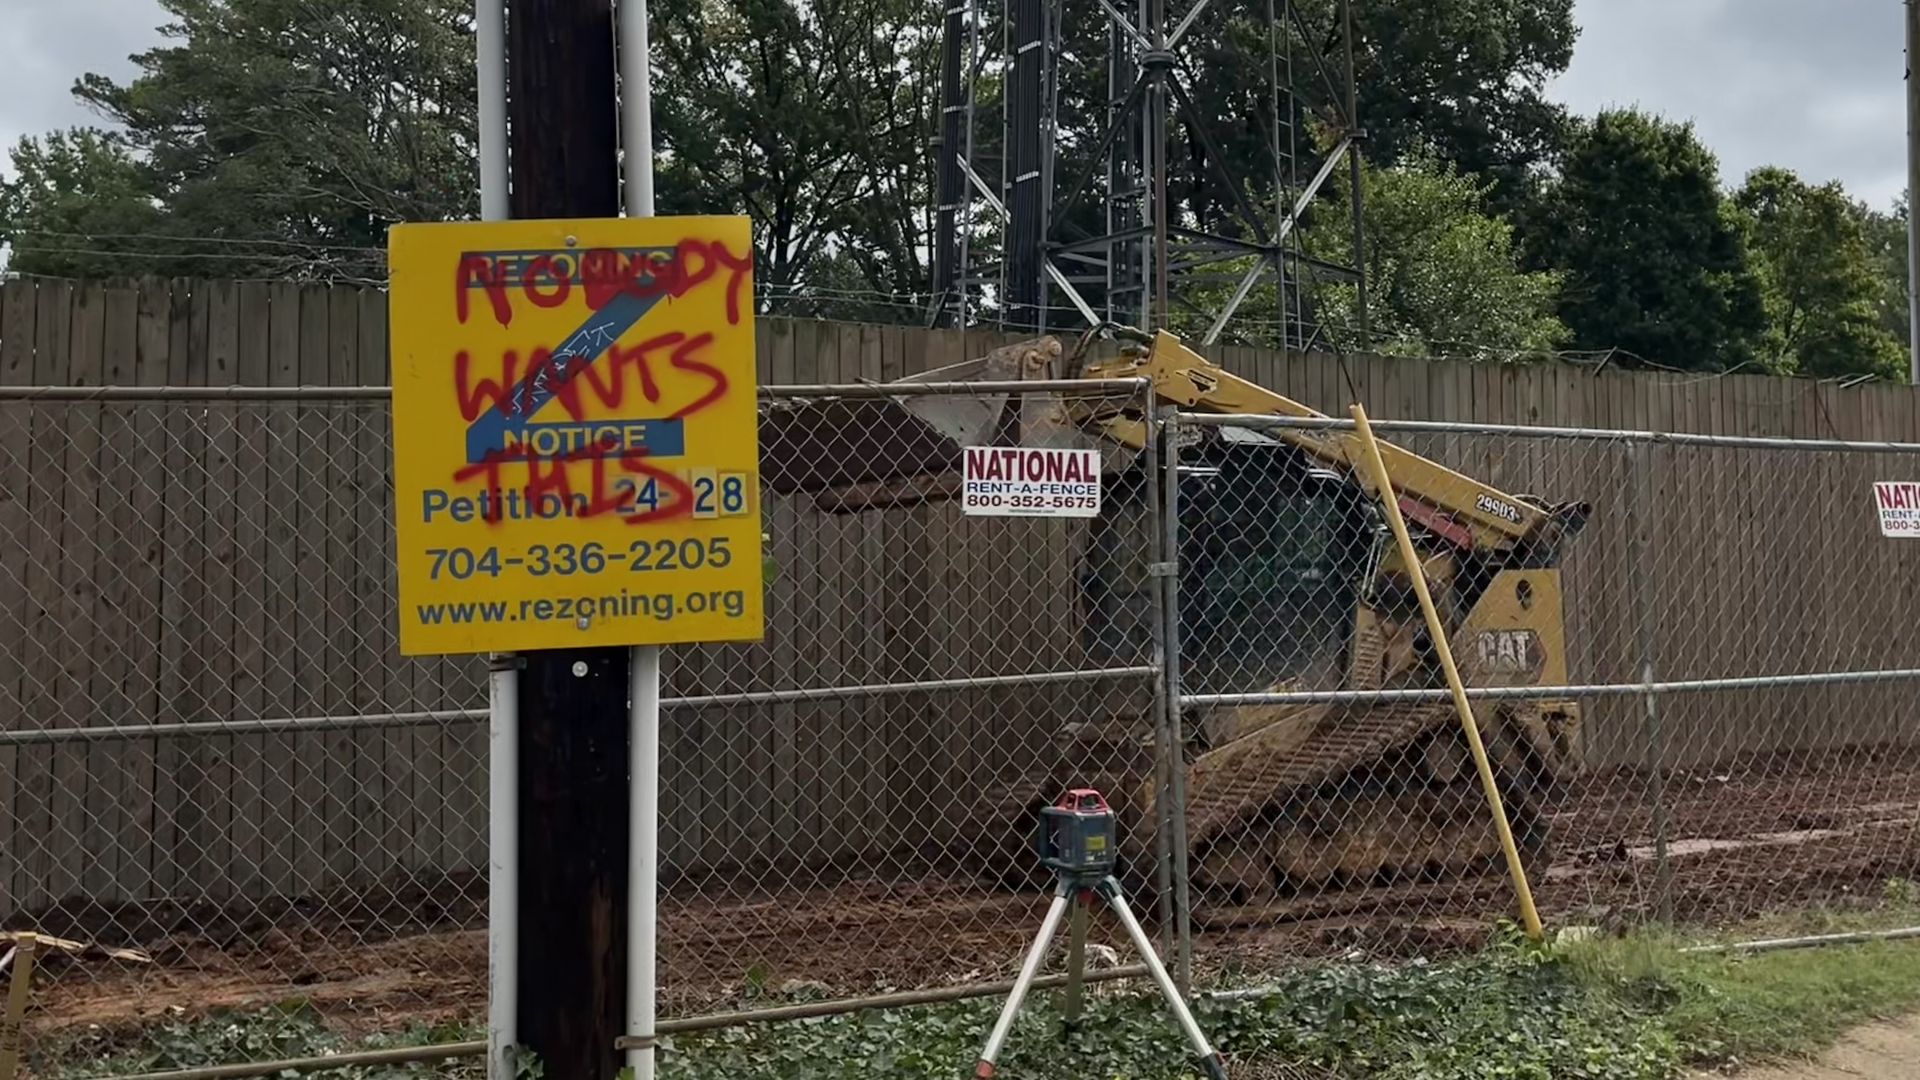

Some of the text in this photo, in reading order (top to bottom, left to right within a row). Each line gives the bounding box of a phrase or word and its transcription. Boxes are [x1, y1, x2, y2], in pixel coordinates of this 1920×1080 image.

[454, 331, 728, 422] WANTS
[503, 424, 647, 456] NOTICE
[453, 435, 694, 526] THIS
[967, 449, 1097, 483] NATIONAL
[422, 486, 588, 523] Petition
[967, 482, 1097, 495] RENT-A-FENCE
[967, 495, 1097, 508] 800-352-5675
[1875, 484, 1920, 509] NATI
[1882, 510, 1920, 519] RENT-
[425, 537, 732, 579] 704-336-2205
[417, 587, 744, 625] www.rezoning.org
[1478, 631, 1530, 672] CAT
